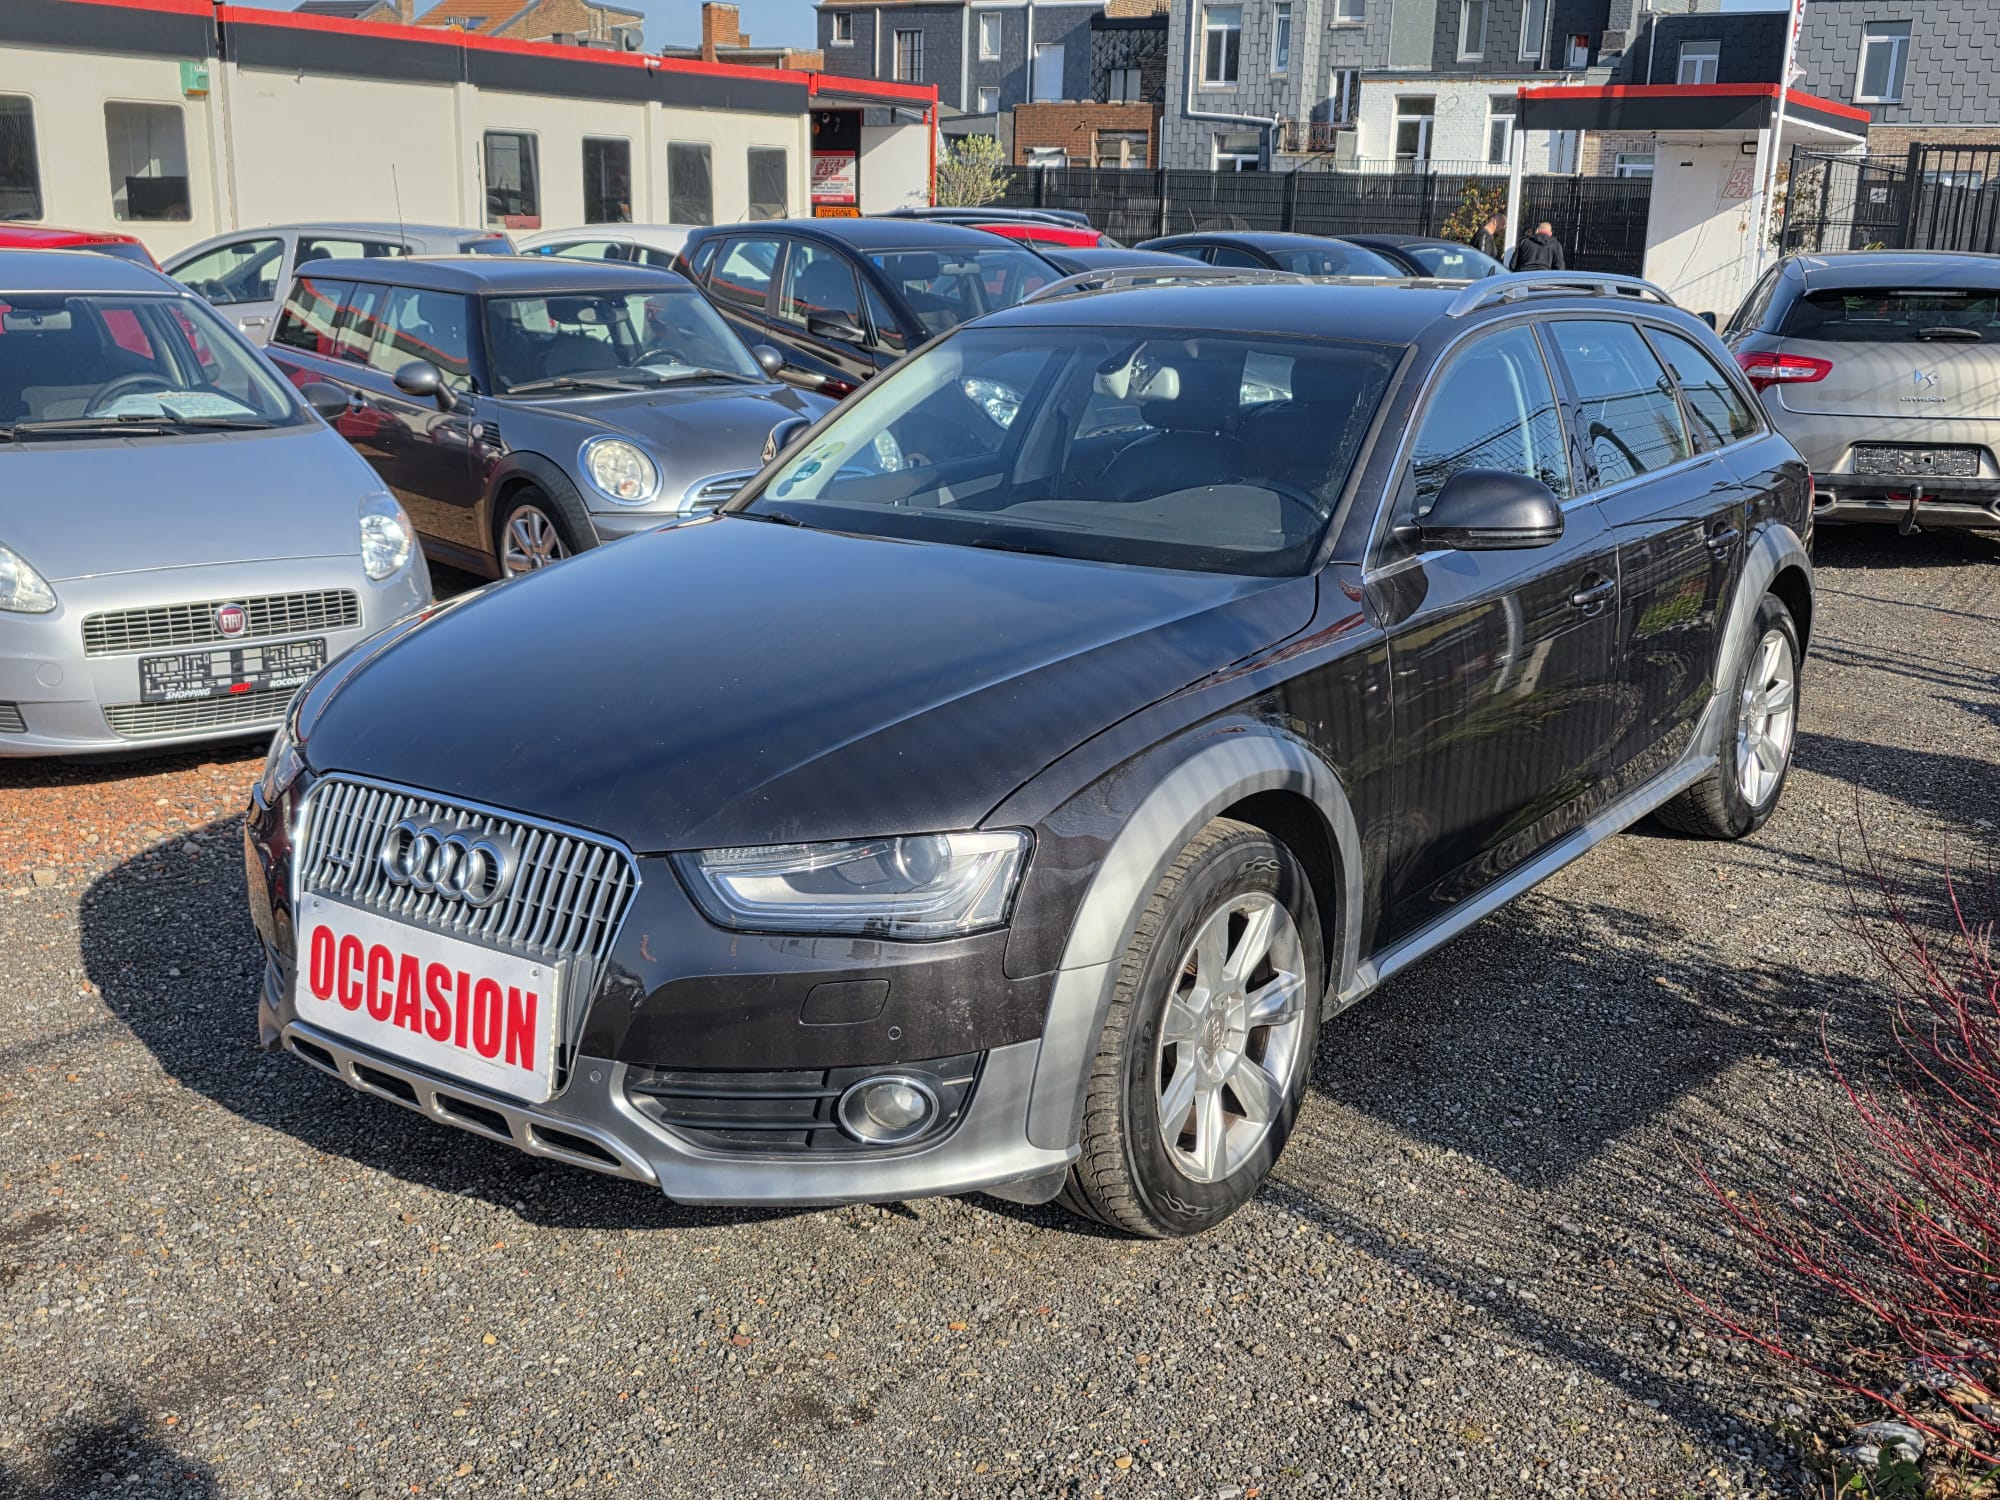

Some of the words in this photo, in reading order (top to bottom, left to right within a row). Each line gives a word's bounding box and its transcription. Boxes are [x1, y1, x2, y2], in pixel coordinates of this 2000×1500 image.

[820, 208, 852, 217] OCCASIONS
[222, 614, 243, 630] FIAT
[165, 688, 212, 700] SHOPPING
[310, 925, 538, 1072] OCCASION
